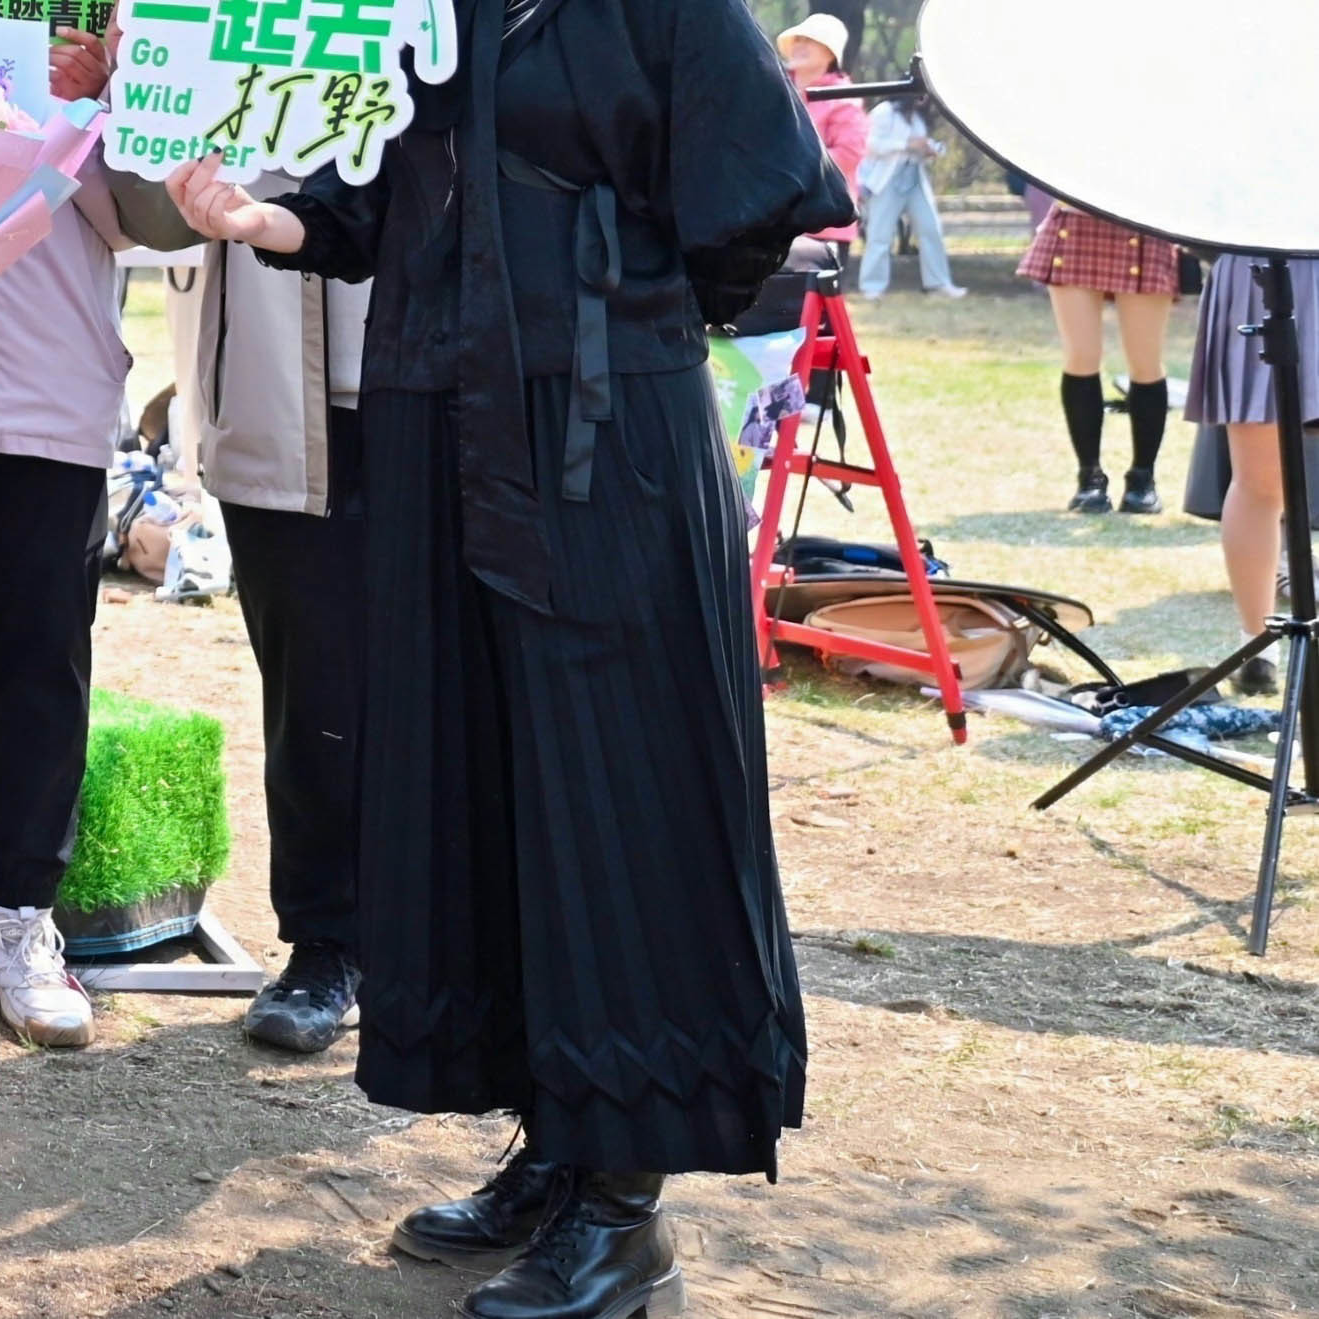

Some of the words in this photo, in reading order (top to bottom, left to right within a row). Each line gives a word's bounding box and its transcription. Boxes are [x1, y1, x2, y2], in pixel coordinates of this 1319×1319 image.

[131, 38, 169, 67] Go
[125, 82, 193, 115] Wild
[205, 63, 395, 167] 打野
